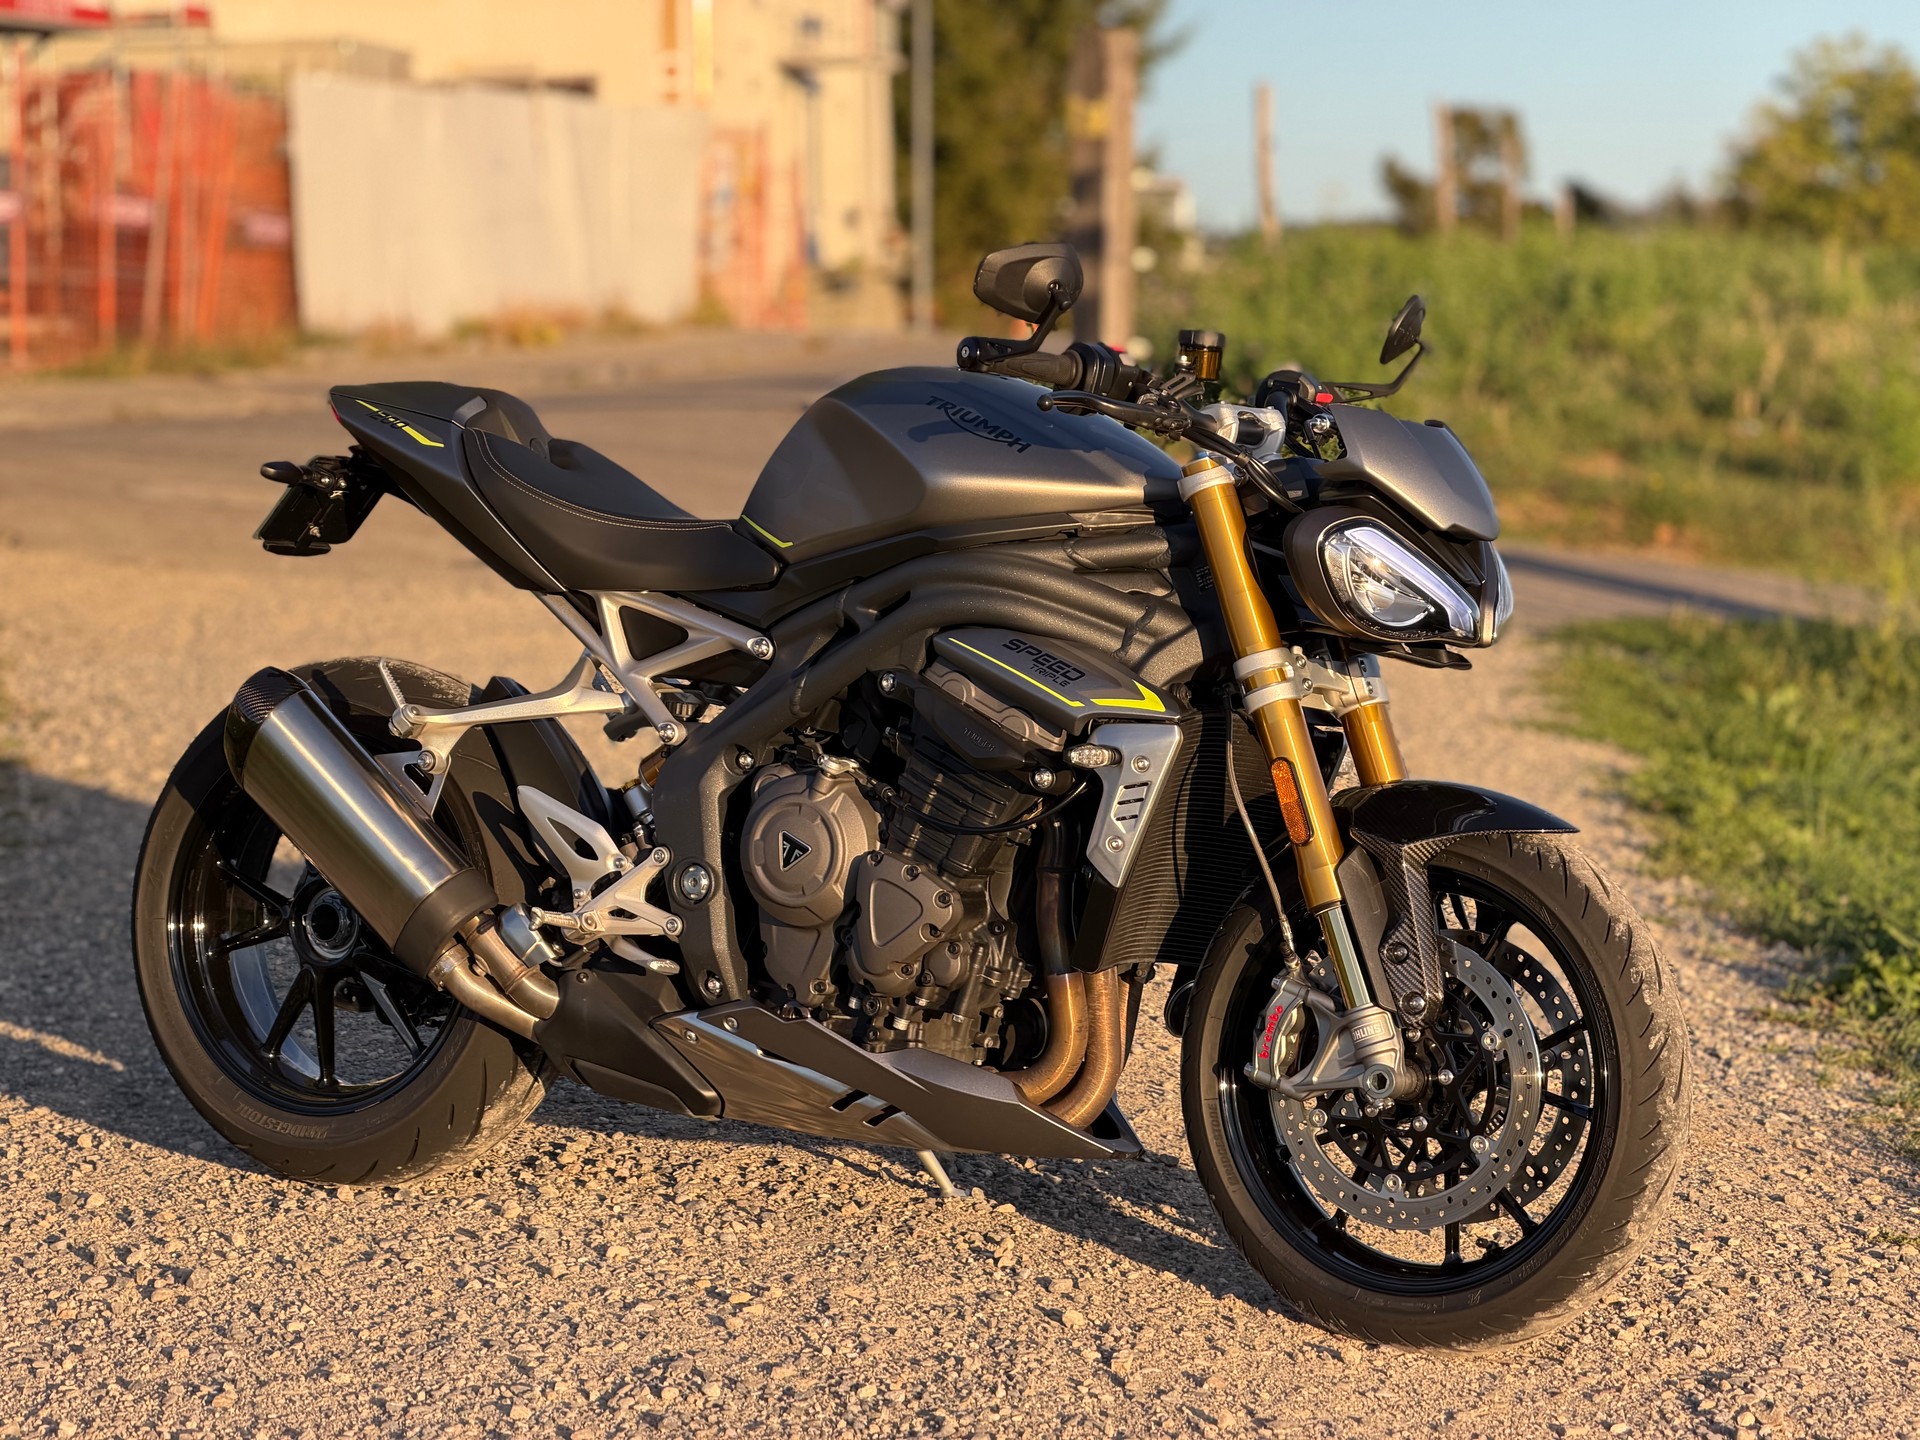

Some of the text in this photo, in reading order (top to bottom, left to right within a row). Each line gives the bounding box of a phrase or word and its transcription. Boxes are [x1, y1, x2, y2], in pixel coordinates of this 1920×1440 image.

[926, 395, 1032, 454] TRIUMPH
[1001, 638, 1086, 682] SPEED
[1030, 663, 1071, 688] TRIPLE
[1258, 1005, 1283, 1059] brembo
